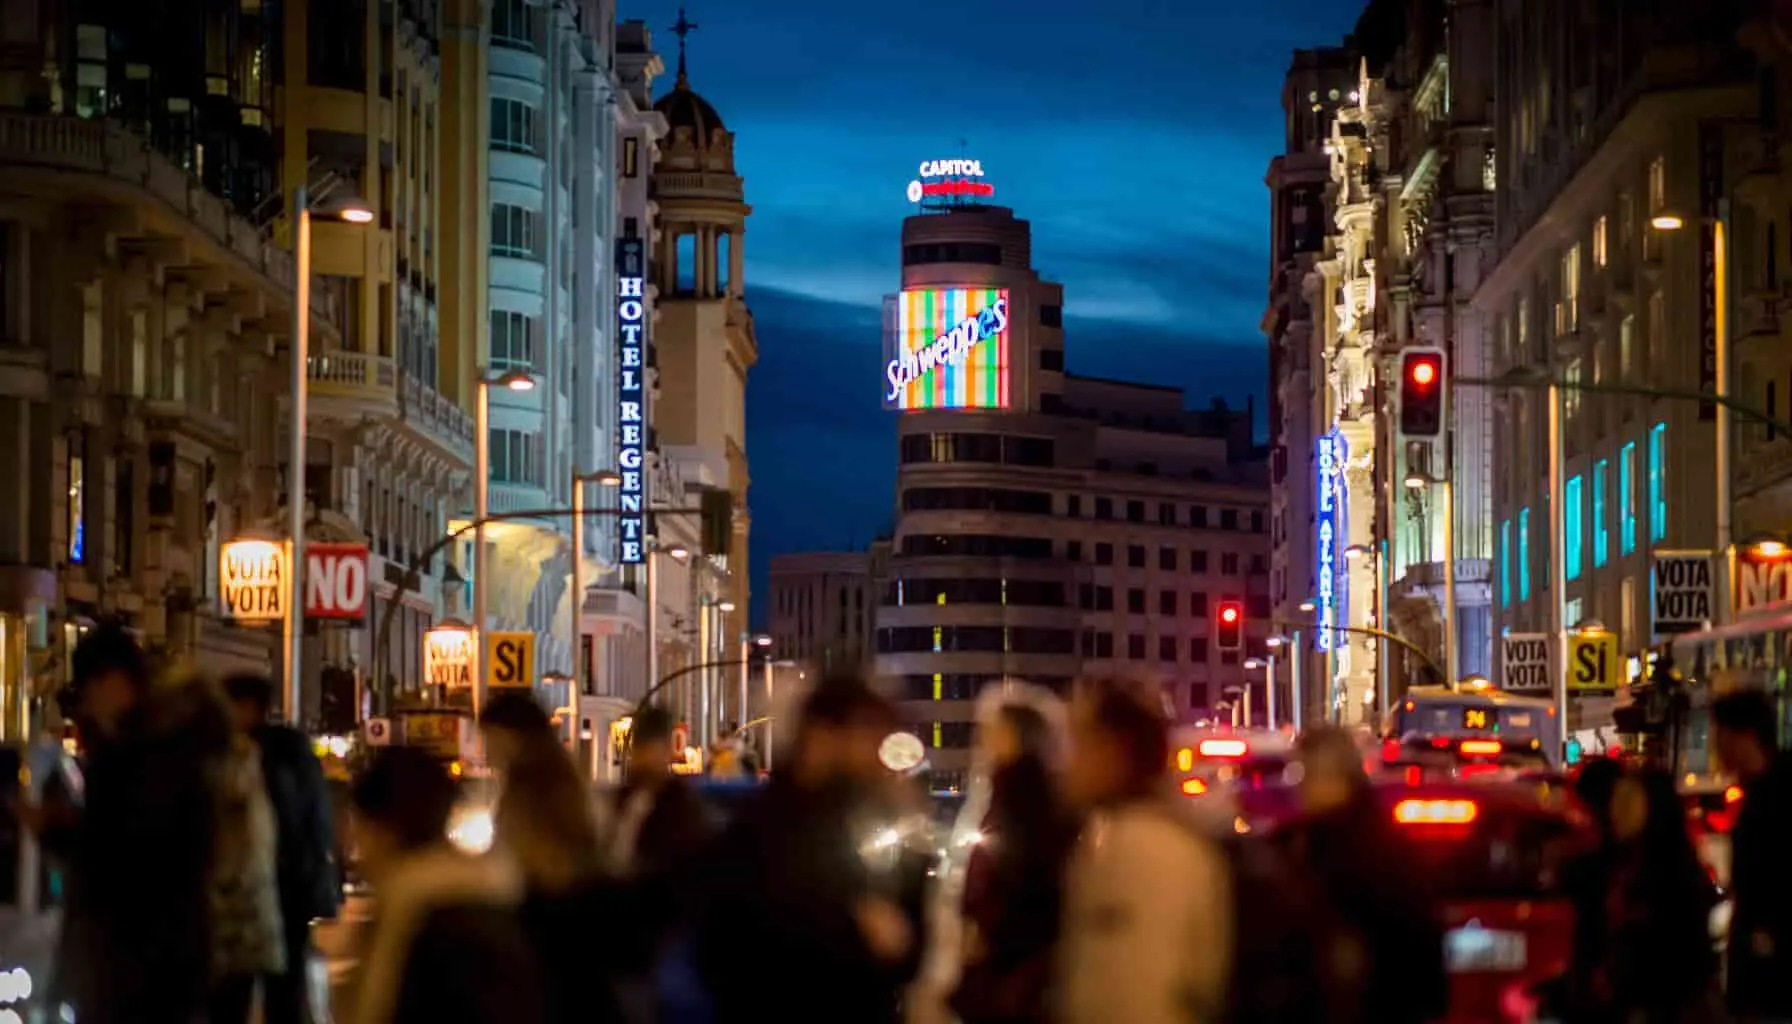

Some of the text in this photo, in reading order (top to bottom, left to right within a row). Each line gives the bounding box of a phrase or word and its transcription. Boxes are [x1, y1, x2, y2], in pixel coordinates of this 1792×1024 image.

[919, 159, 984, 177] CAPITOL
[886, 299, 1006, 401] Schweppes
[620, 277, 642, 561] HOTEL REGENTE
[1319, 439, 1334, 512] HOTEL
[307, 555, 365, 611] NO
[1656, 559, 1710, 587] VOTA
[226, 585, 280, 612] VOTA
[1656, 590, 1710, 619] VOTA
[1506, 640, 1547, 662] VOTA
[430, 664, 470, 683] VOTA
[1506, 664, 1547, 686] VOTA
